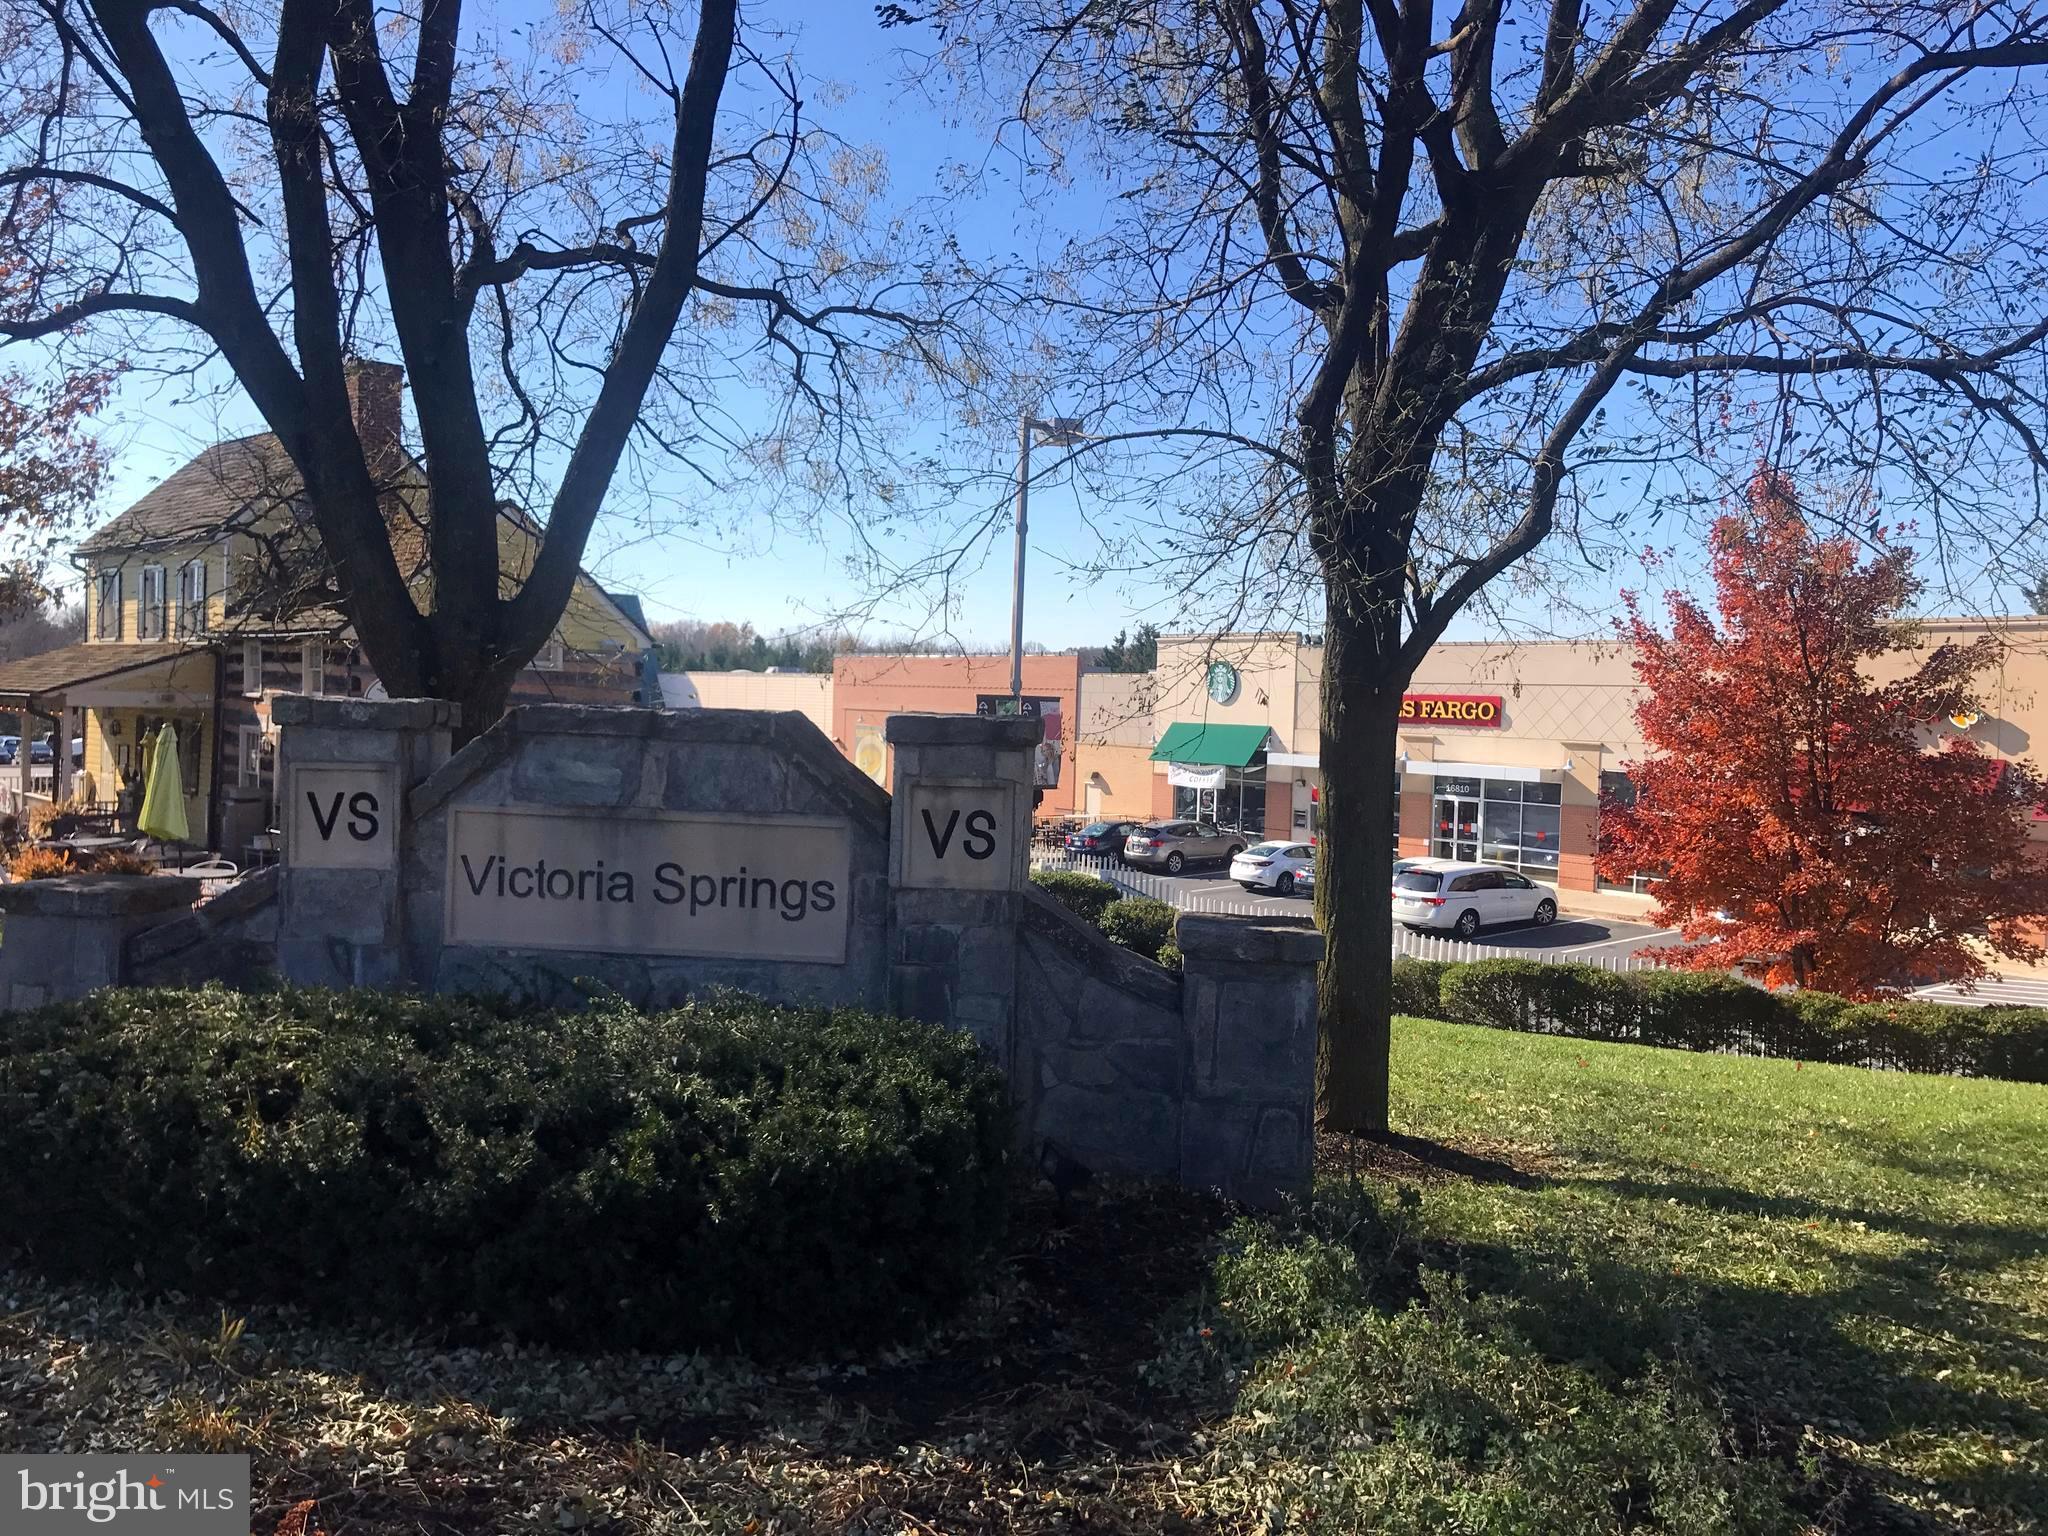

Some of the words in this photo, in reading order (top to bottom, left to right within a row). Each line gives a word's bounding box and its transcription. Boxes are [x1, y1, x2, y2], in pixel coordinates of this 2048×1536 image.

[1420, 700, 1495, 720] FARGO
[1446, 784, 1470, 793] 16810
[306, 791, 379, 841] VS
[921, 809, 996, 860] VS
[461, 854, 634, 903] Victoria
[653, 862, 836, 921] Springs
